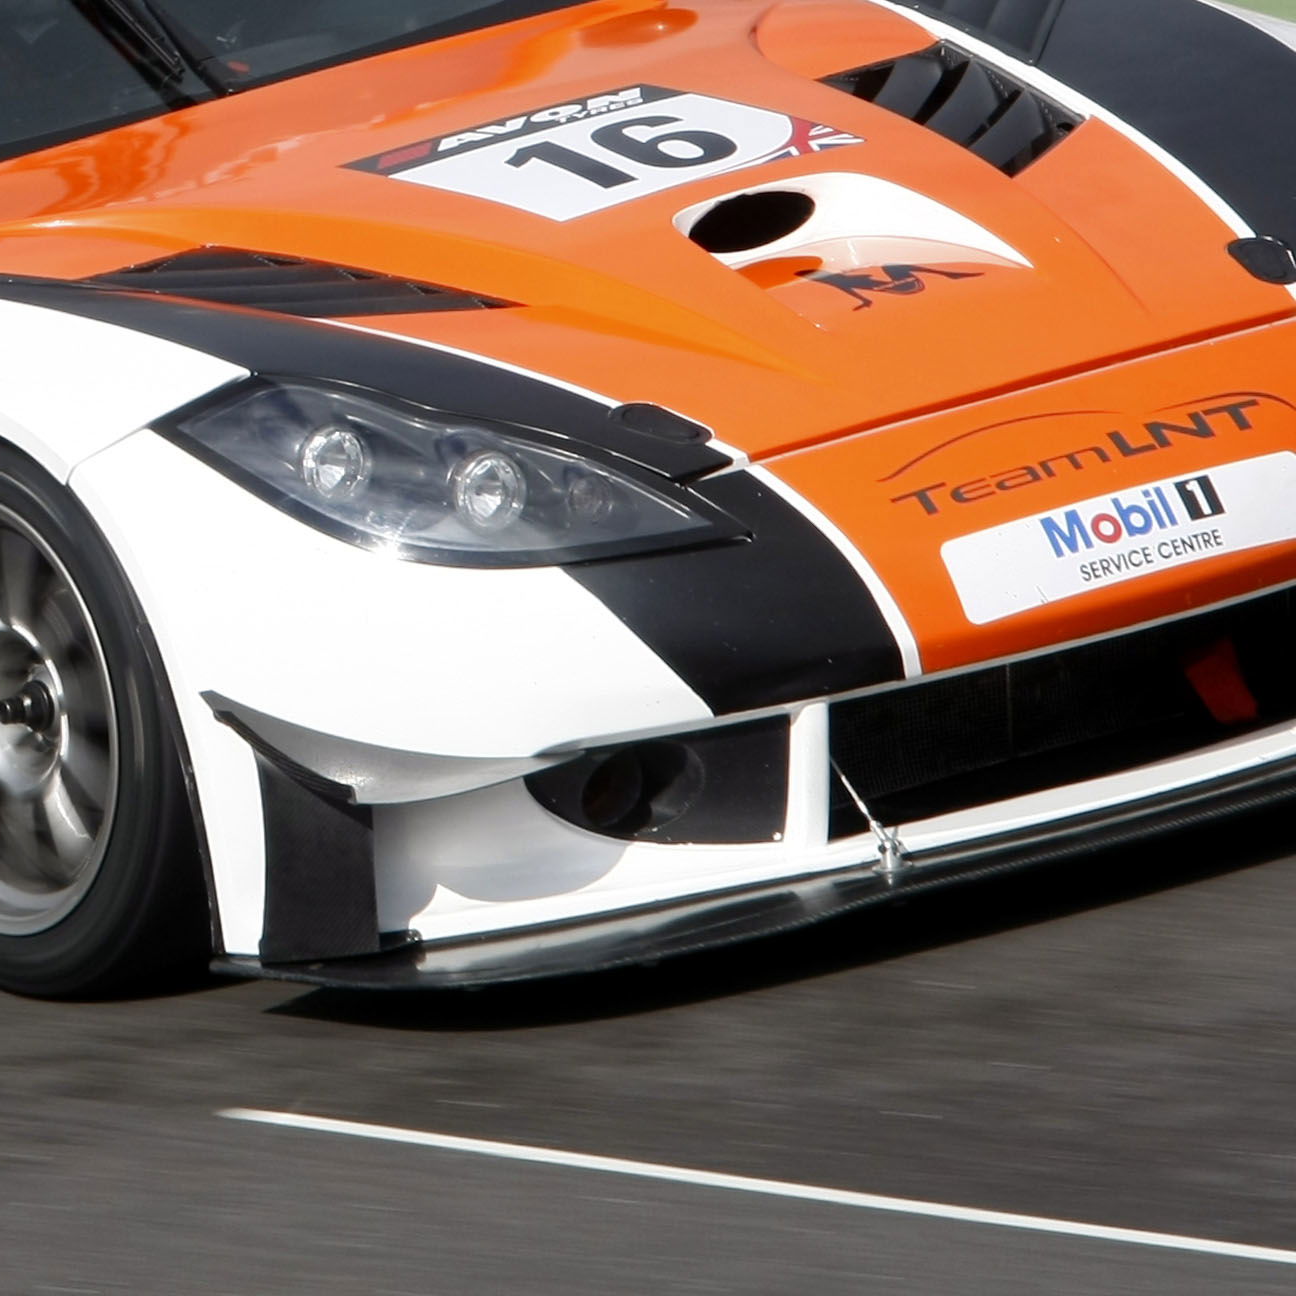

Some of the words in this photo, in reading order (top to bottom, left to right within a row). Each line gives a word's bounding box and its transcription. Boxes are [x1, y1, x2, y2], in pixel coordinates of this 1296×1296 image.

[437, 87, 642, 152] AVON
[504, 115, 738, 189] 16
[1039, 486, 1178, 559] Mobil
[1079, 544, 1155, 582] SERVICE
[1157, 529, 1224, 561] CENTRE
